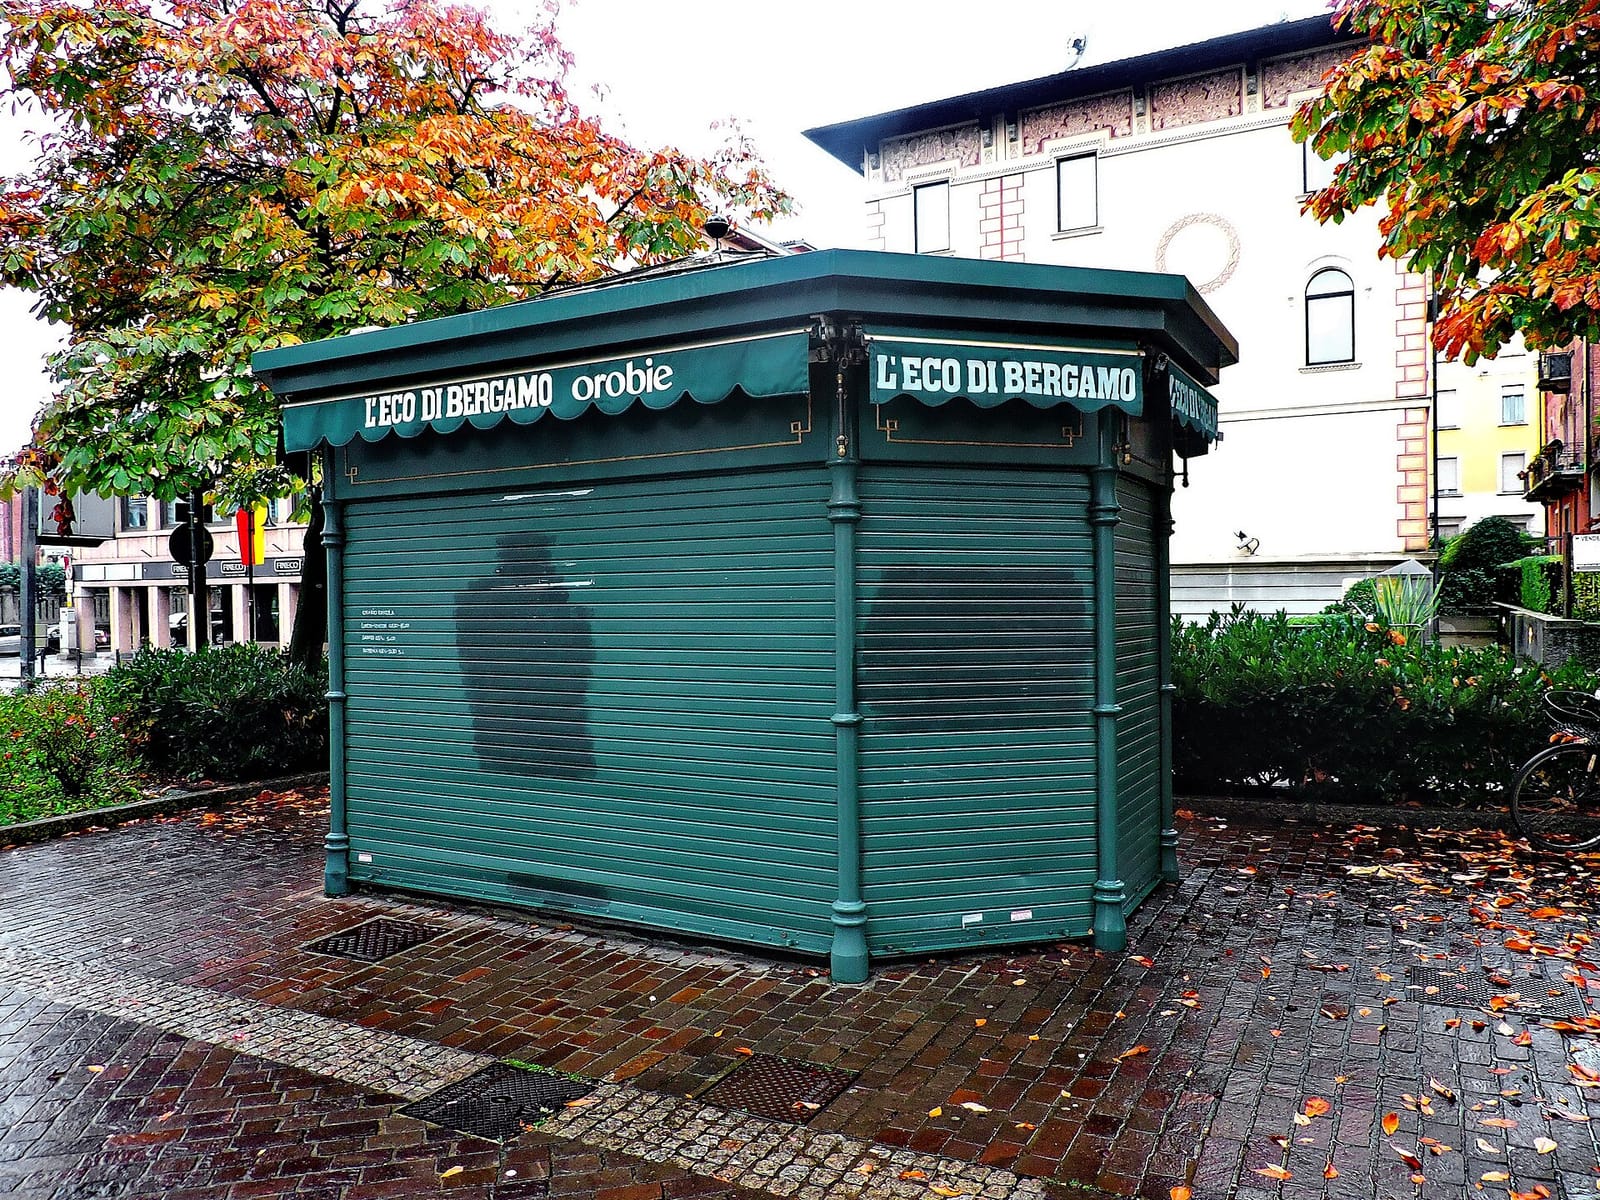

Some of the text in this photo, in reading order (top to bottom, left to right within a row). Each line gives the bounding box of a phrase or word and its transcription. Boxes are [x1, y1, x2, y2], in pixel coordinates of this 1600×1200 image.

[365, 373, 553, 428] L'ECO DI BERGAMO
[571, 357, 674, 402] orobie
[876, 354, 1137, 402] L'ECO DI BERGAMO
[276, 561, 299, 570] FINECO
